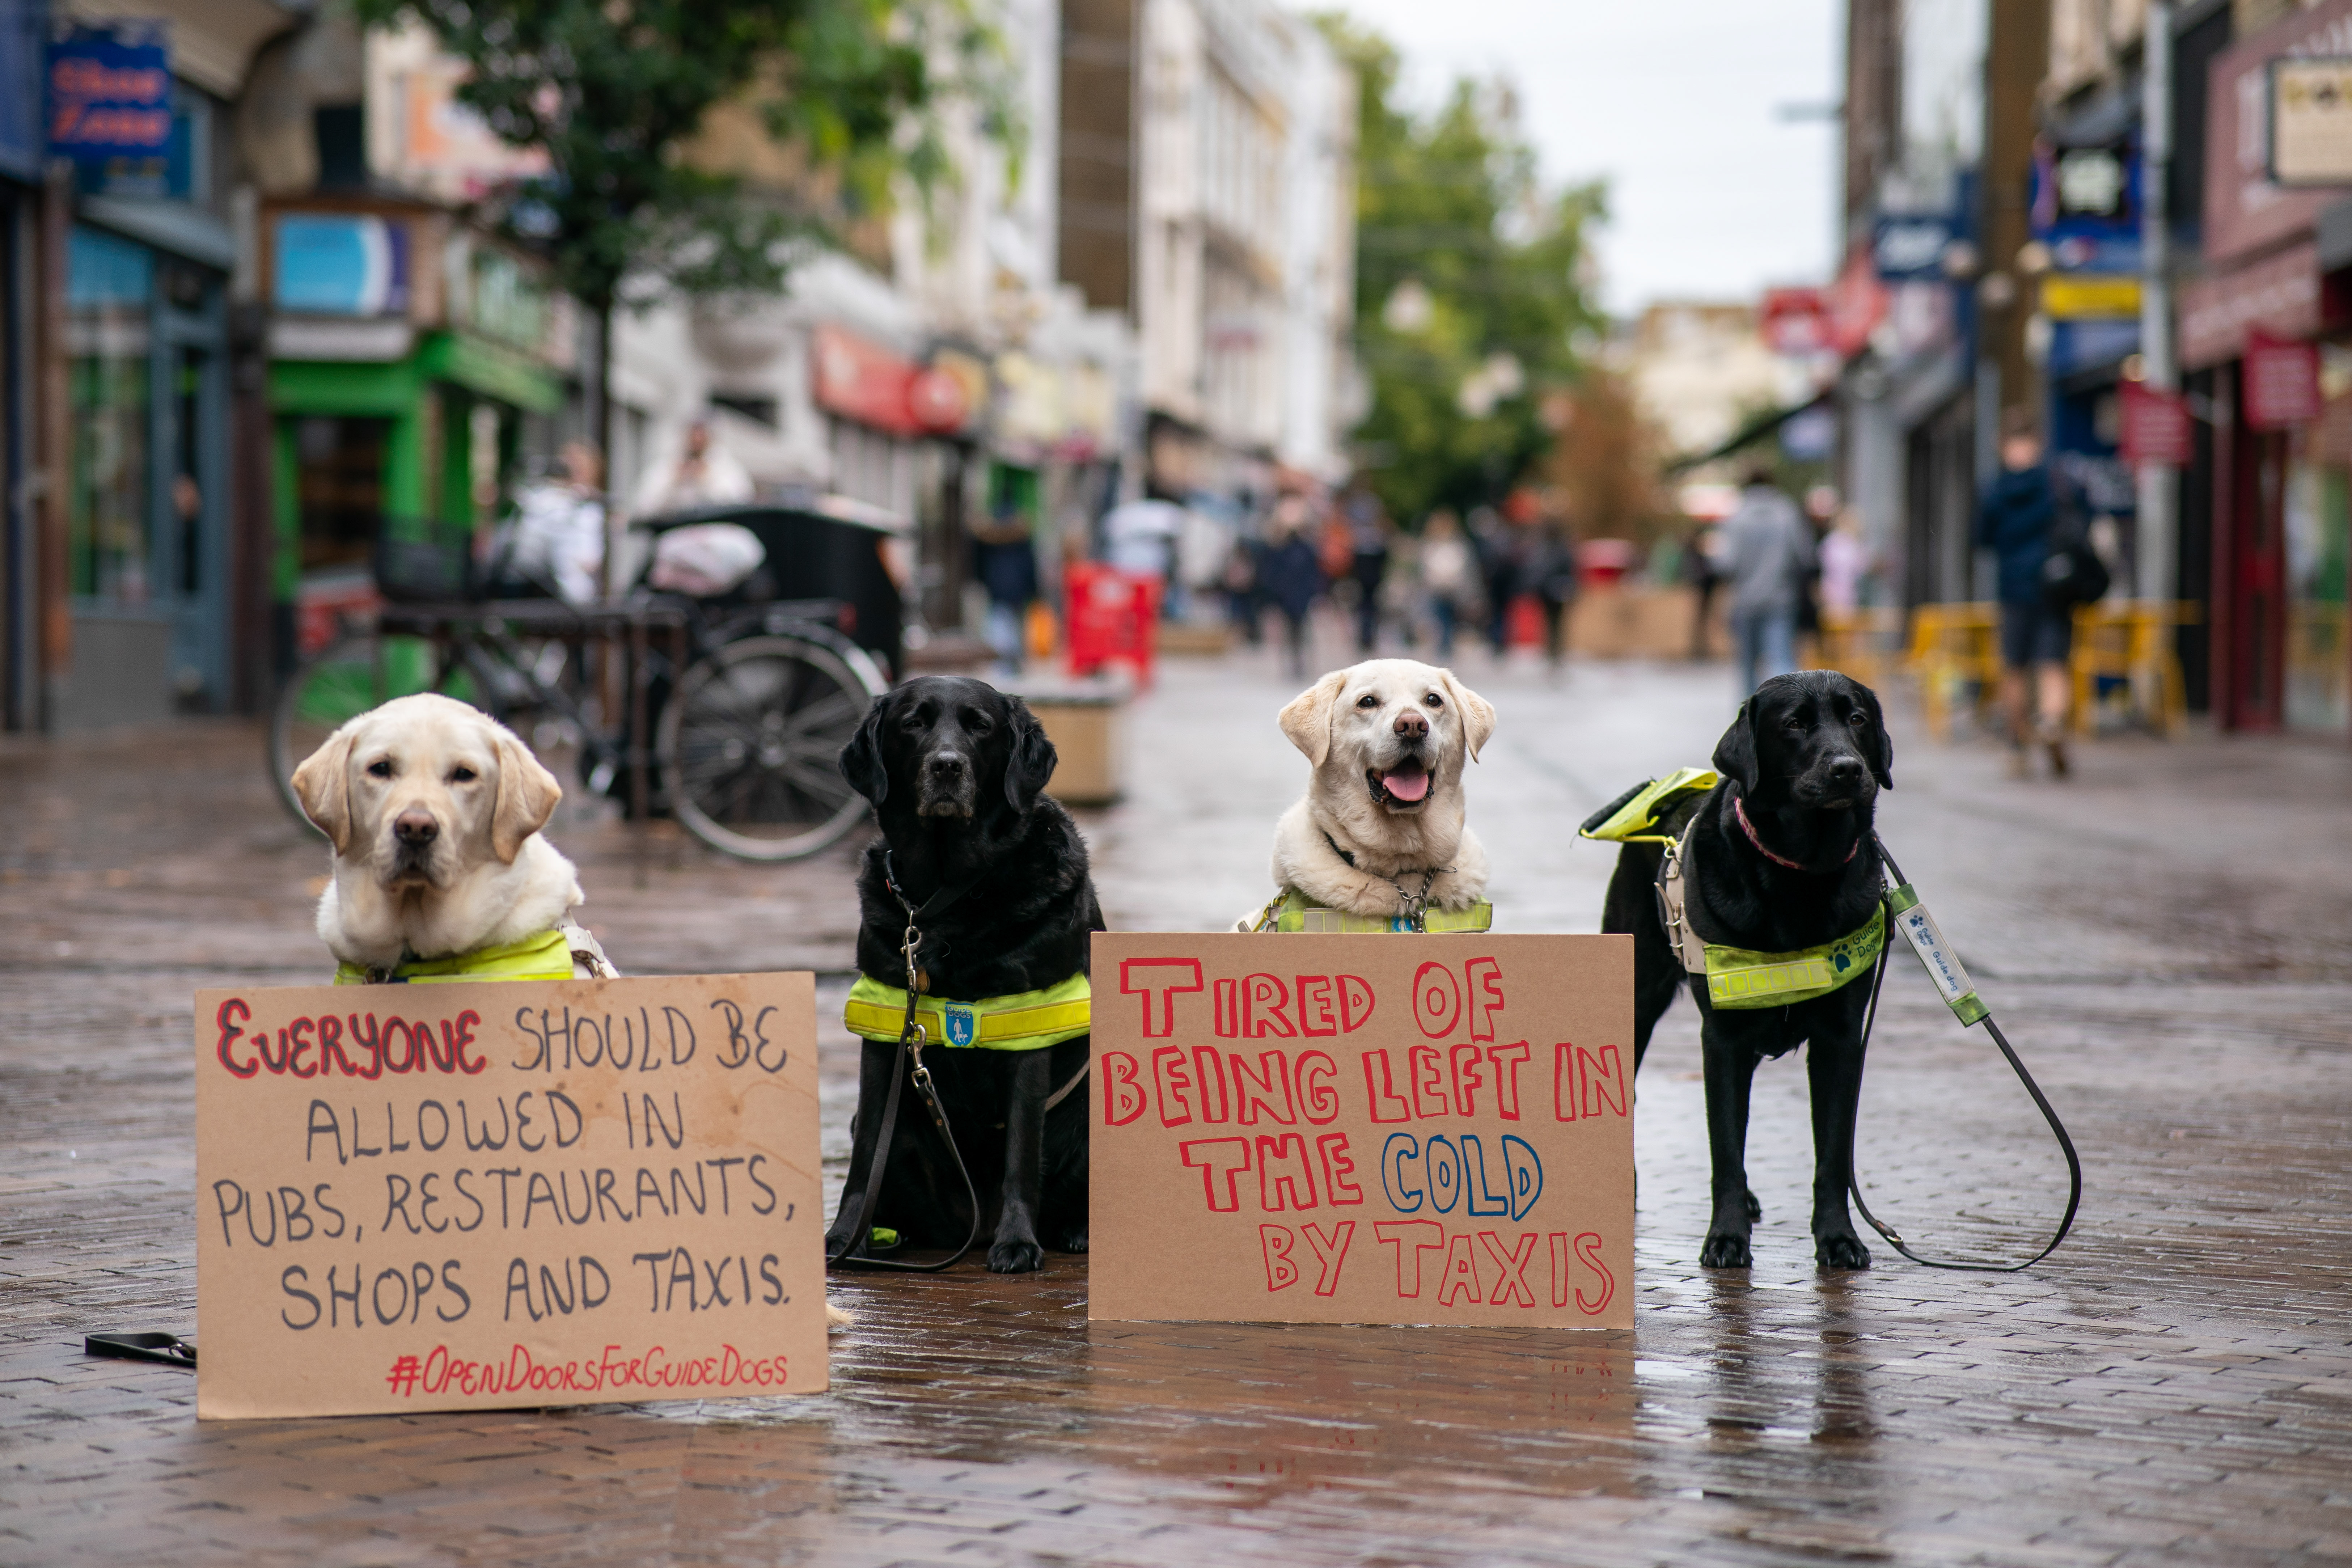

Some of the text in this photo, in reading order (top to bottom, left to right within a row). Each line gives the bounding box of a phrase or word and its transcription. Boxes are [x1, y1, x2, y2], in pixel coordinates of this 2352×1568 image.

[1853, 922, 1879, 944] Guide
[1917, 930, 1927, 946] Dogs
[1922, 927, 1933, 945] Guide
[1933, 951, 1958, 992] Guide dog
[217, 997, 787, 1080] EVERYONE SHOULD BE
[1119, 956, 1505, 1042] TIRED OF
[1101, 1040, 1626, 1128] BEING LEFT IN
[308, 1091, 684, 1165] ALLOWED IN
[213, 1155, 794, 1247] PUBS, RESTAURANTS,
[1179, 1132, 1542, 1222] THE COLD
[282, 1247, 790, 1330] SHOPS AND TAXIS.
[1259, 1219, 1614, 1315] BY TAXIS
